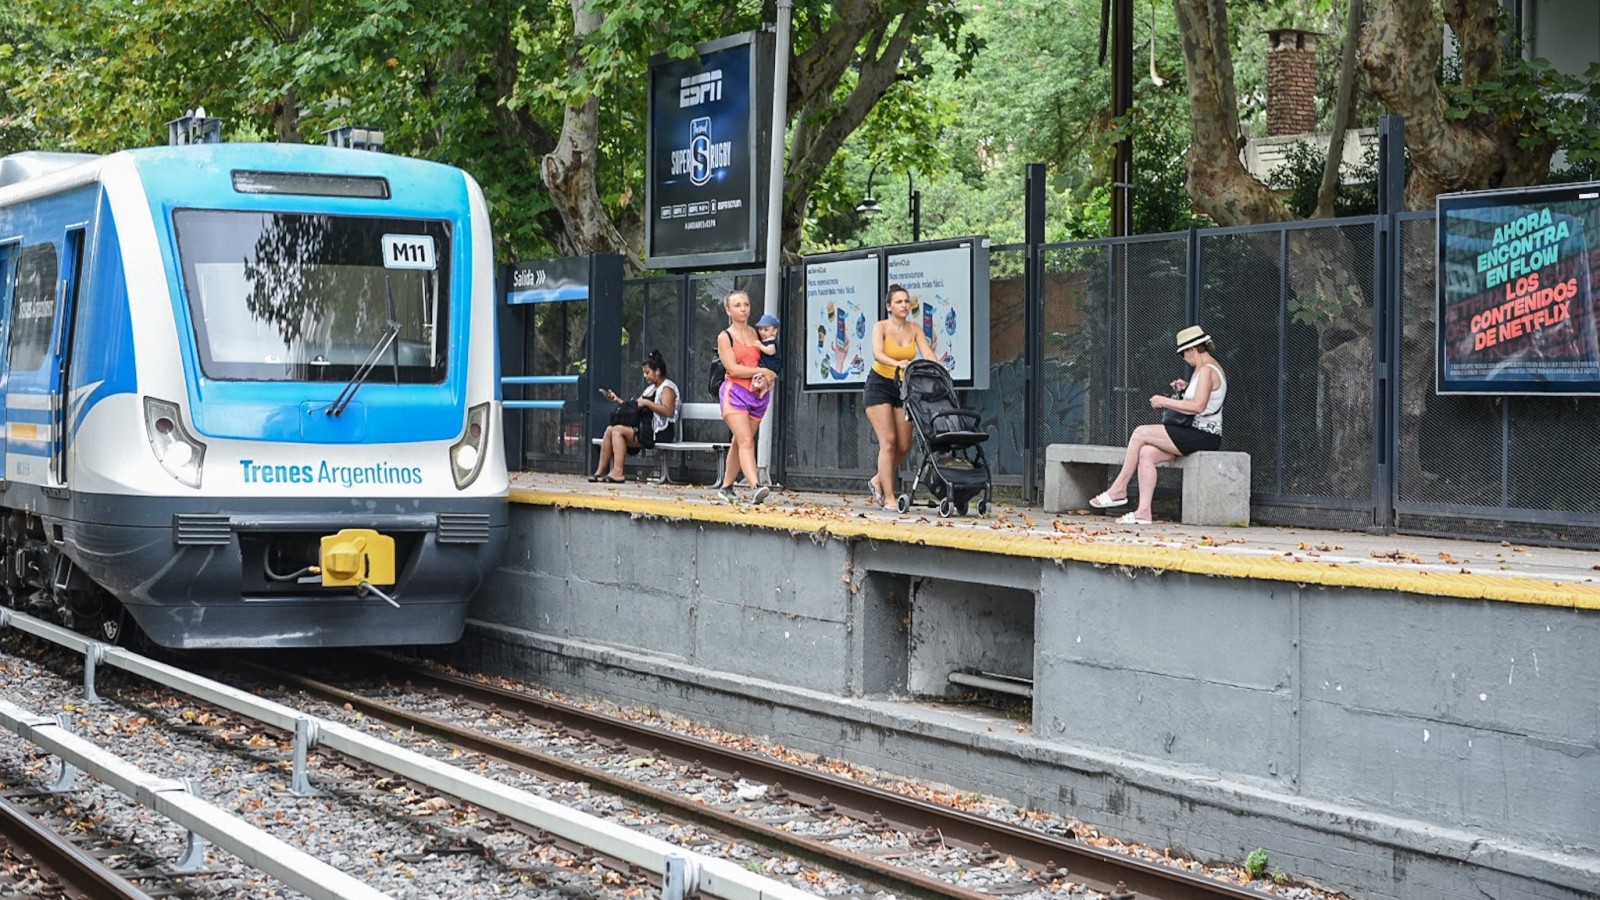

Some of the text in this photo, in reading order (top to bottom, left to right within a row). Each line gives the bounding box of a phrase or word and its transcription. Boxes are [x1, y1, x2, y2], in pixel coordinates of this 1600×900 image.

[680, 69, 723, 108] ESPN
[671, 149, 692, 176] SUPER
[710, 141, 732, 169] RUGBY
[1491, 207, 1553, 247] AHORA
[392, 242, 427, 262] M11
[1477, 221, 1570, 273] ENCONTRA
[1486, 244, 1559, 289] EN FLOW
[513, 268, 534, 287] Salida
[1505, 272, 1540, 301] LOS
[1470, 277, 1578, 334] CONTENIDOS
[1474, 330, 1497, 352] DE
[1498, 300, 1571, 343] NETFLIX
[240, 460, 423, 488] Trenes Argentinos
